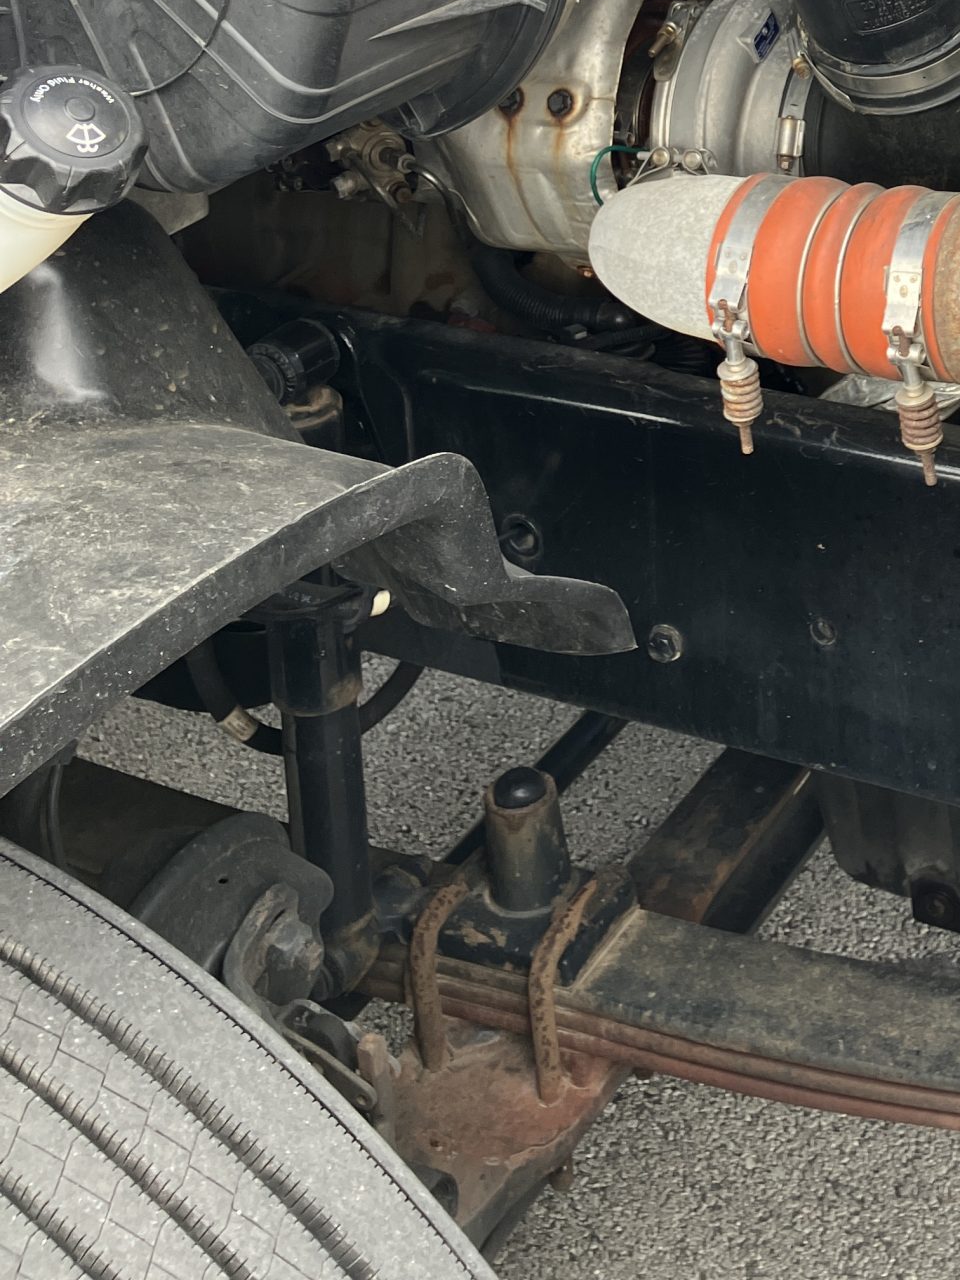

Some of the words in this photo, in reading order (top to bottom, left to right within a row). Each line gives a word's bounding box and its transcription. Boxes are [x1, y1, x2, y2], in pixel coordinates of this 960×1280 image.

[46, 75, 76, 87] Fluid
[78, 78, 115, 104] Washer
[29, 83, 50, 103] Only
